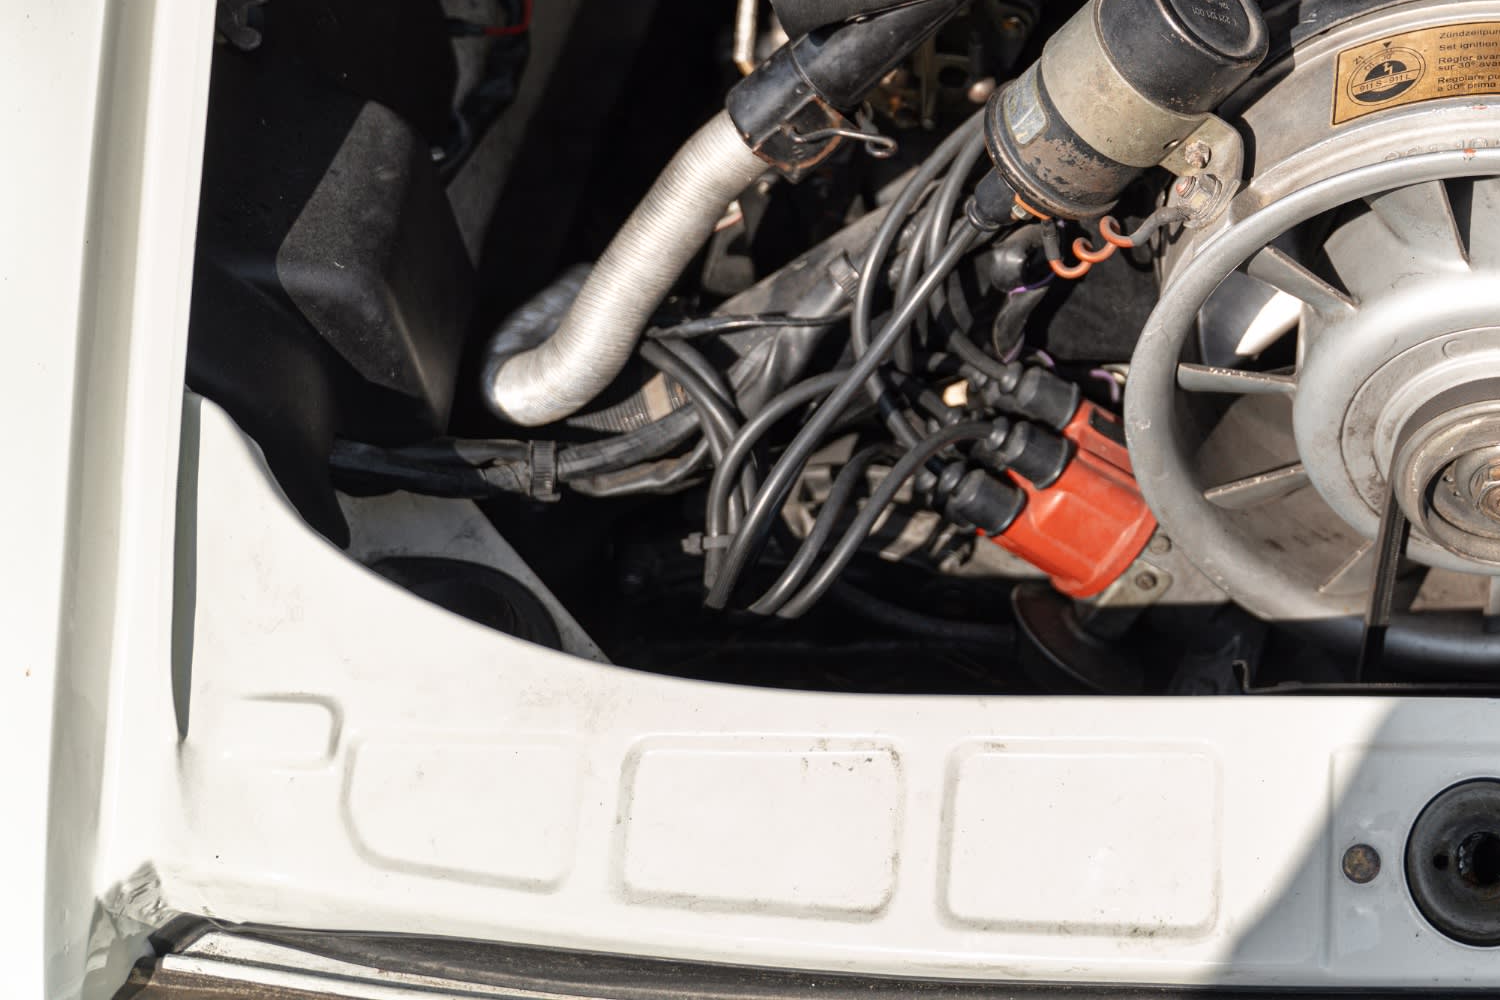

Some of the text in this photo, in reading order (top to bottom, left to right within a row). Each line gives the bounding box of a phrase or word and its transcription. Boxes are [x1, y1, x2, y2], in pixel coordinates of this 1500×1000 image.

[1439, 43, 1457, 51] Set
[1460, 40, 1498, 50] ignition
[1438, 63, 1456, 71] sur
[1359, 83, 1373, 91] 911
[1388, 75, 1403, 84] 911
[1467, 81, 1497, 89] prima
